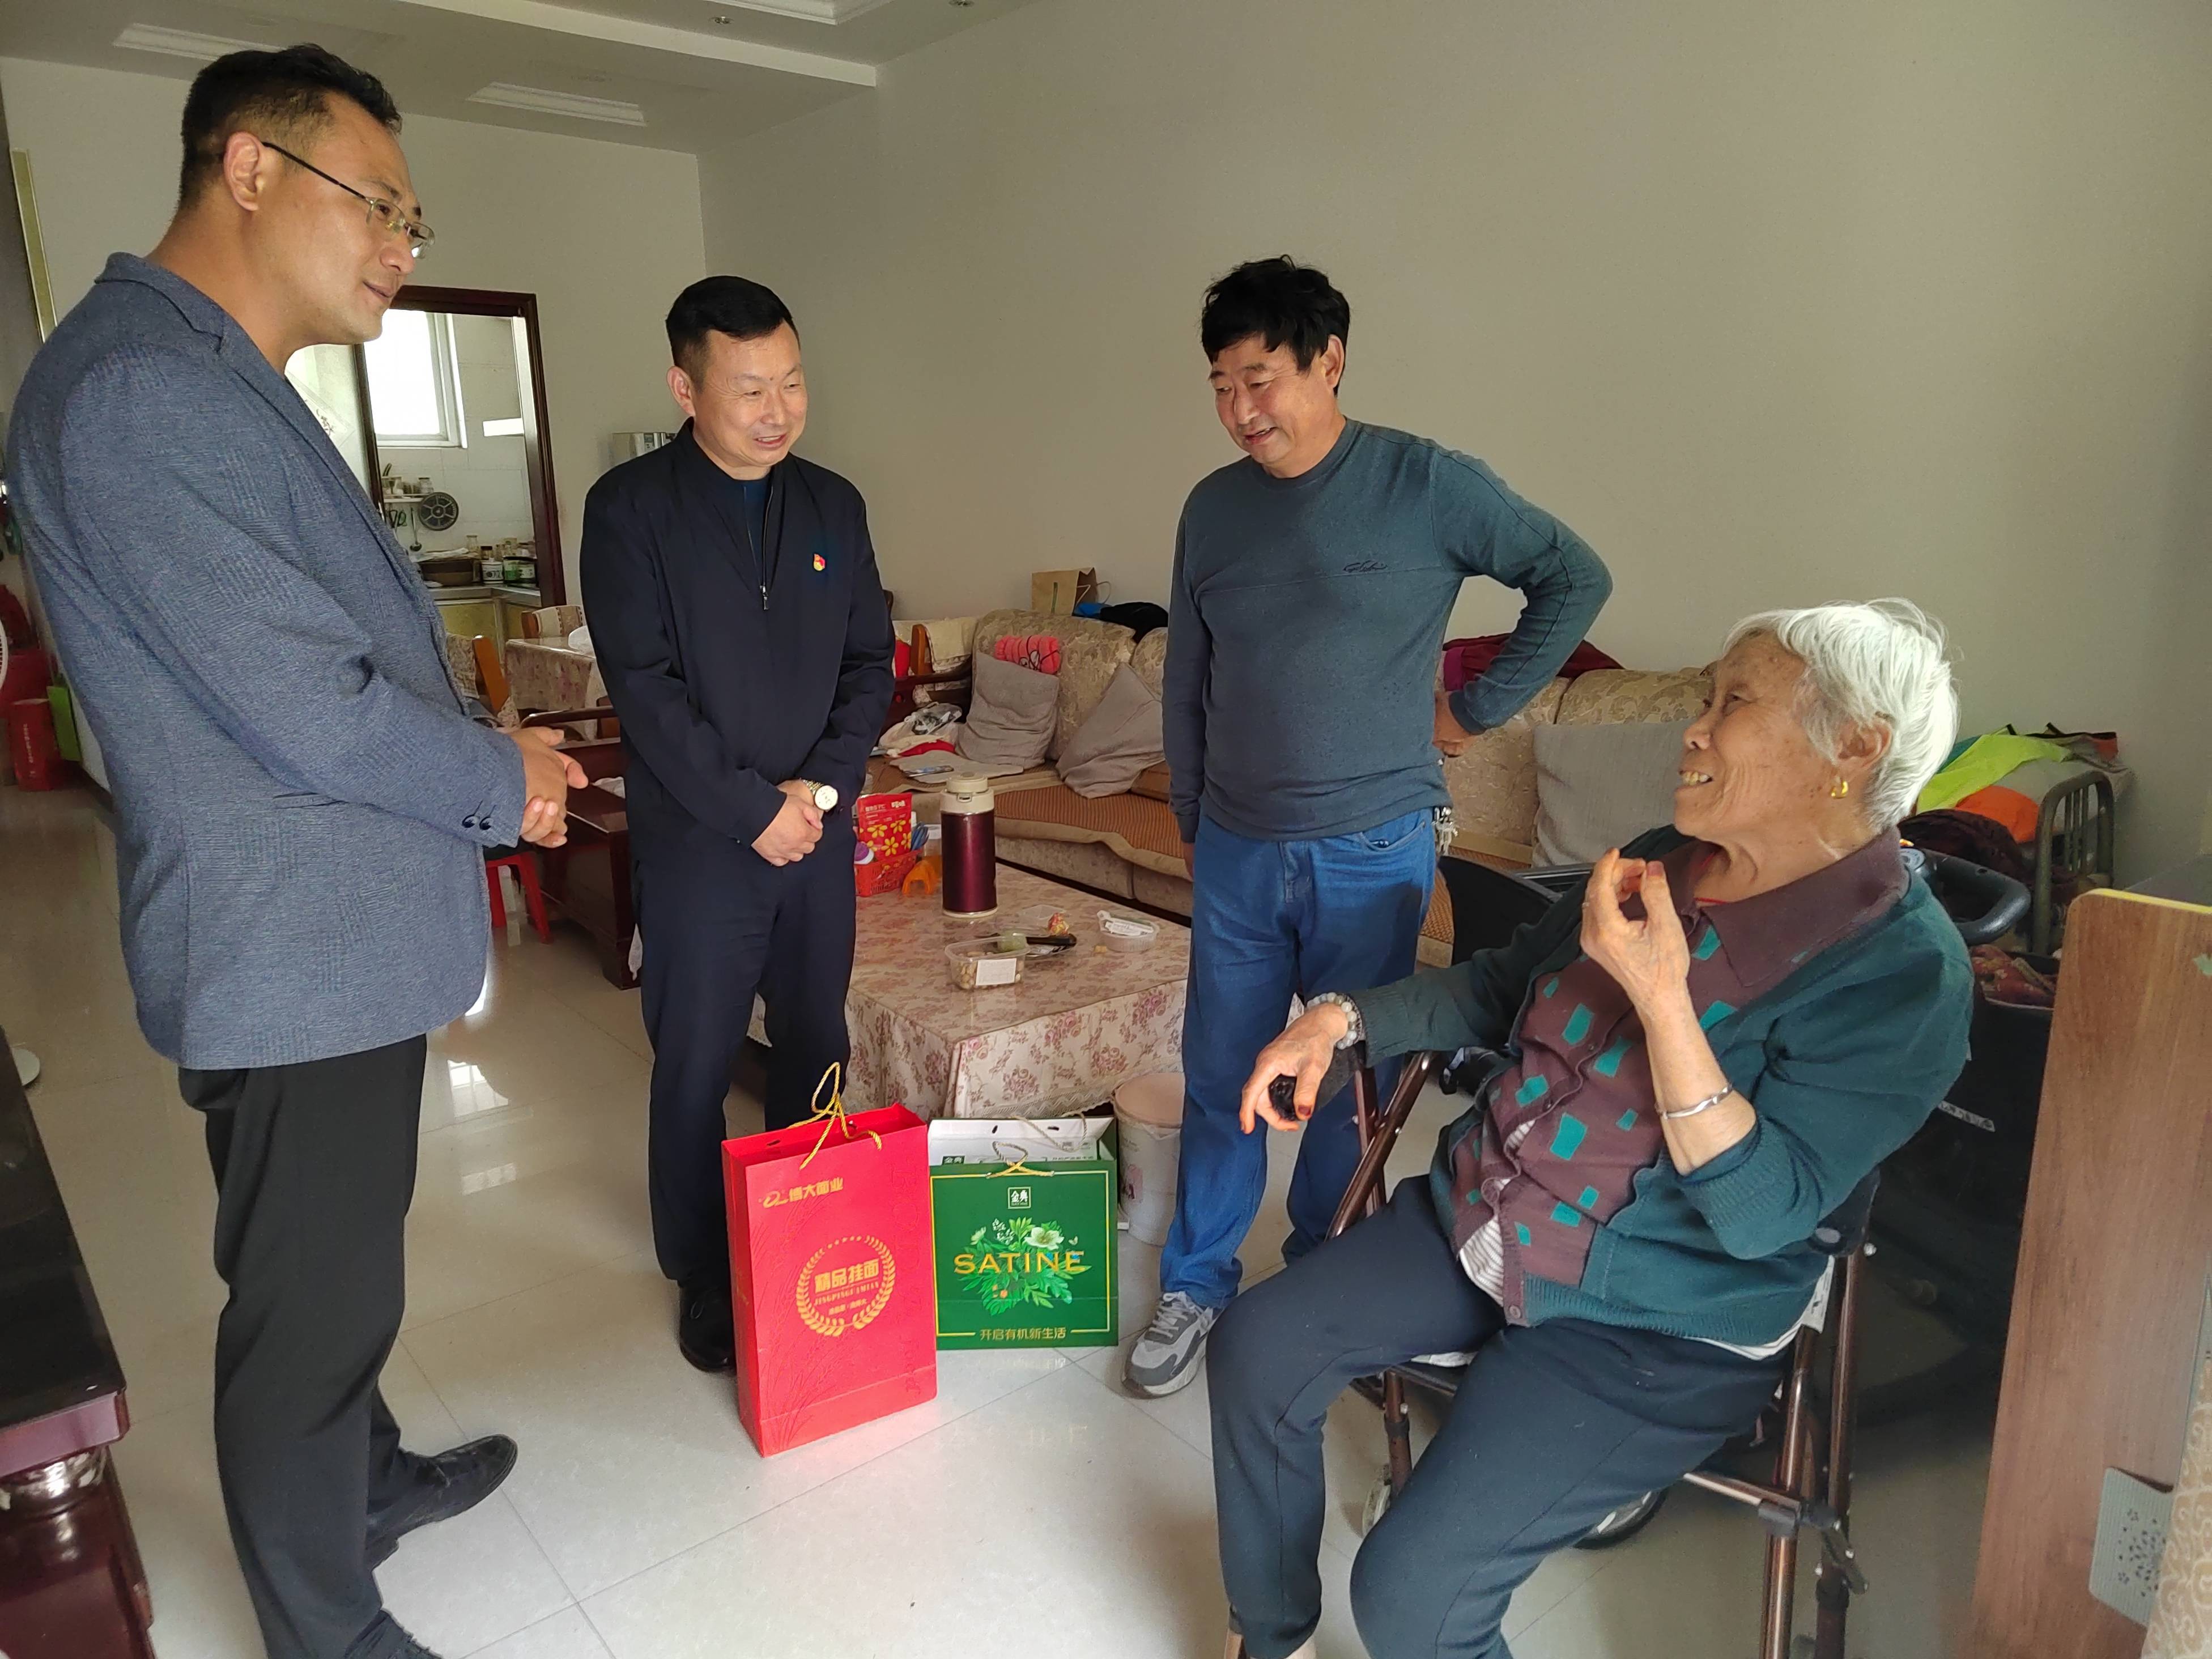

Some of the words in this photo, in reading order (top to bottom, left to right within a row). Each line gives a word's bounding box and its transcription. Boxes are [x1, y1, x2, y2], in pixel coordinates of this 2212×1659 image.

[1011, 1189, 1028, 1202] 金典
[954, 1250, 1084, 1274] SATINE
[814, 1258, 879, 1294] 精品挂面
[980, 1326, 1067, 1342] 开启有机新生活
